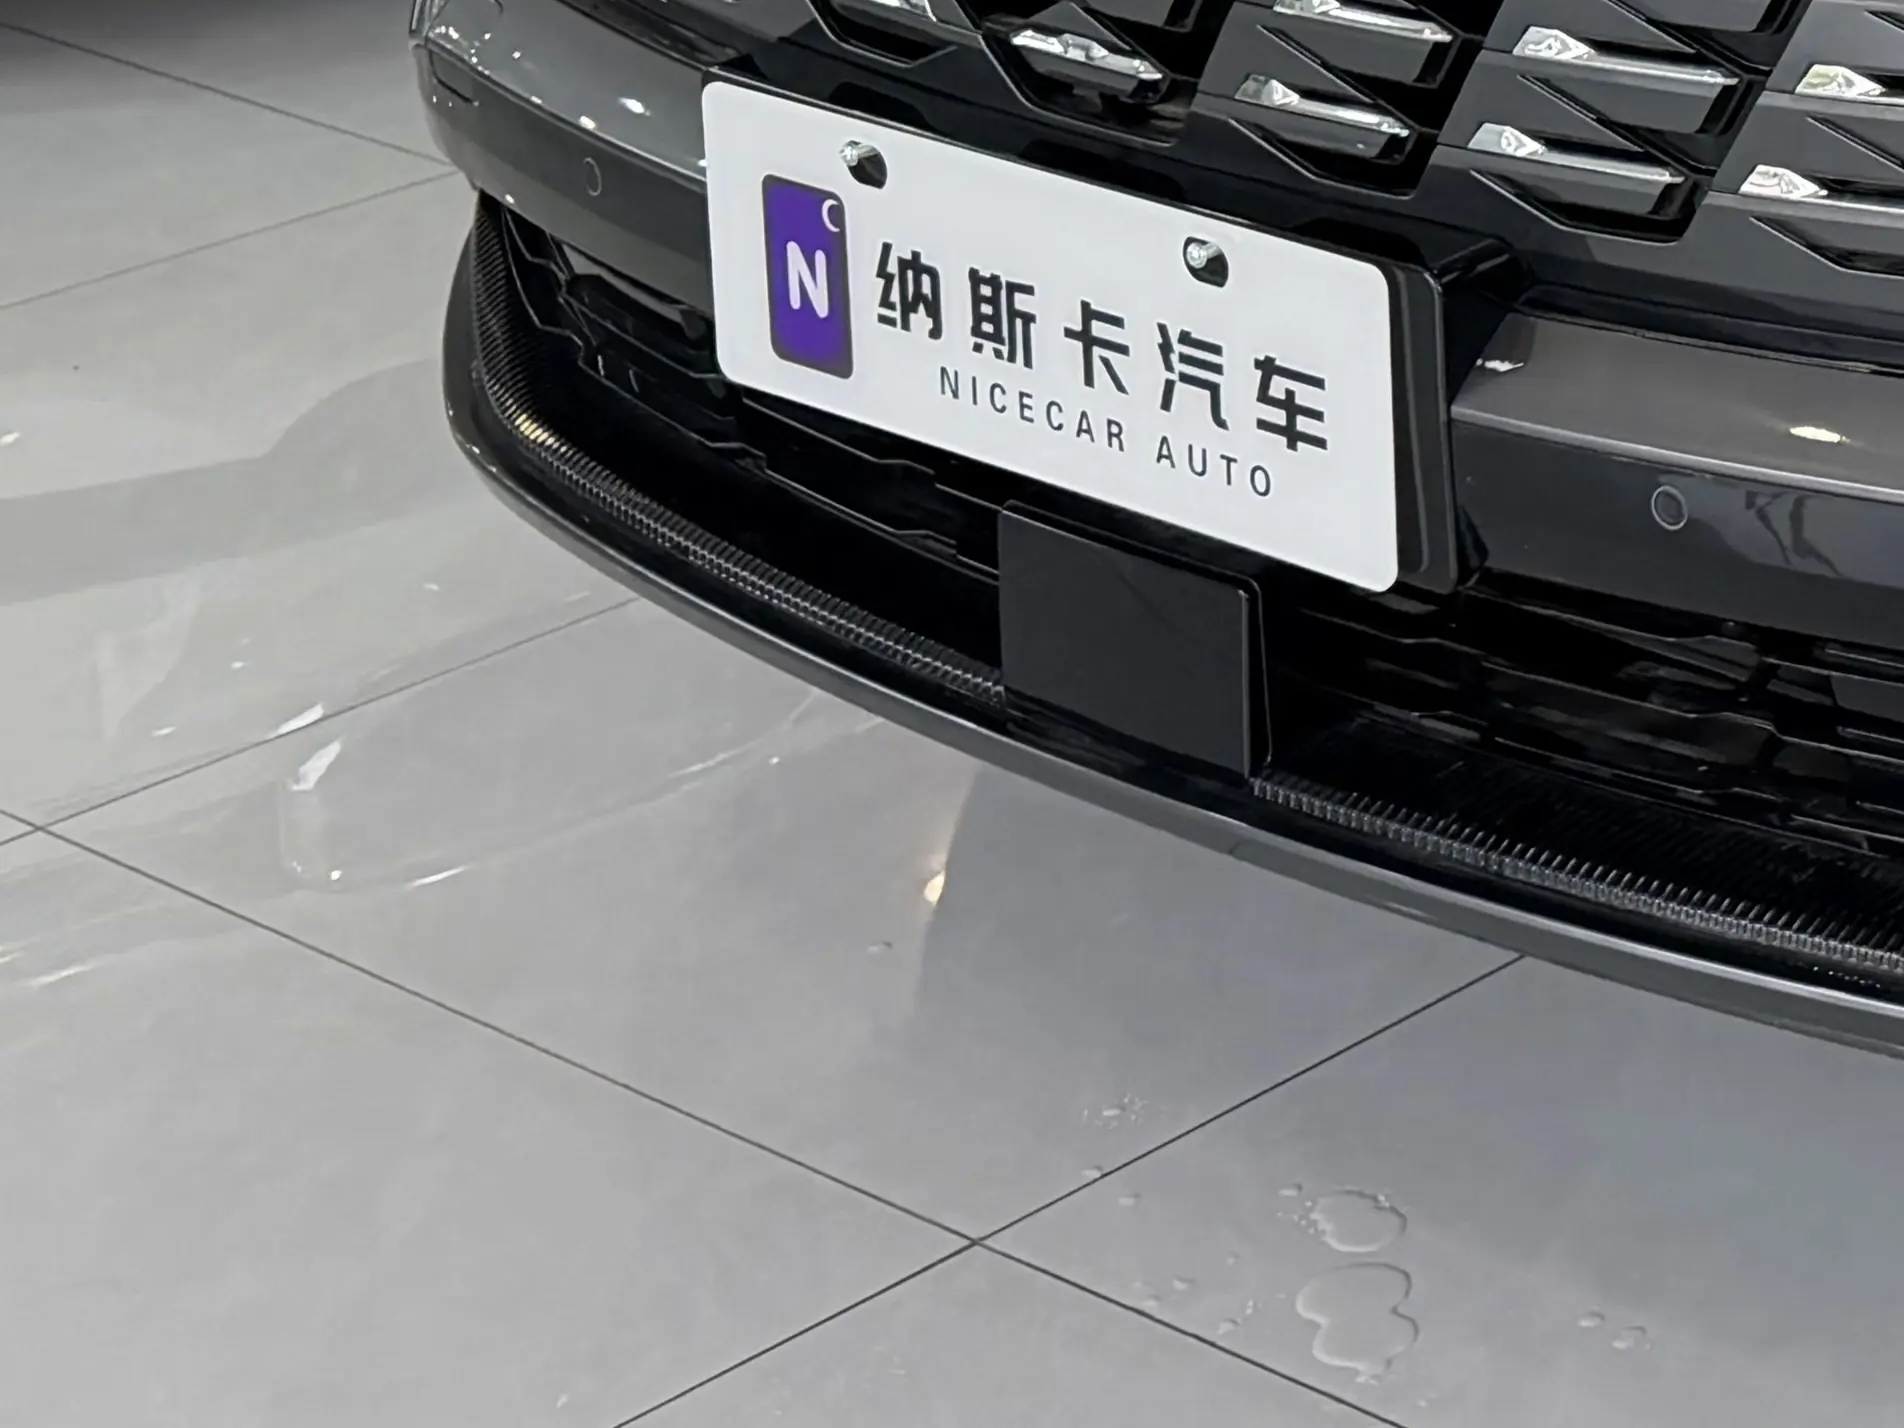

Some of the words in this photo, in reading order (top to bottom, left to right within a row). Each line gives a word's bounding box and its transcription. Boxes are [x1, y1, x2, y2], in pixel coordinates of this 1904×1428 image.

[786, 240, 830, 319] N
[874, 240, 1329, 453] 纳斯卡汽车
[940, 365, 1127, 454] NICECAR
[1156, 435, 1274, 499] AUTO
